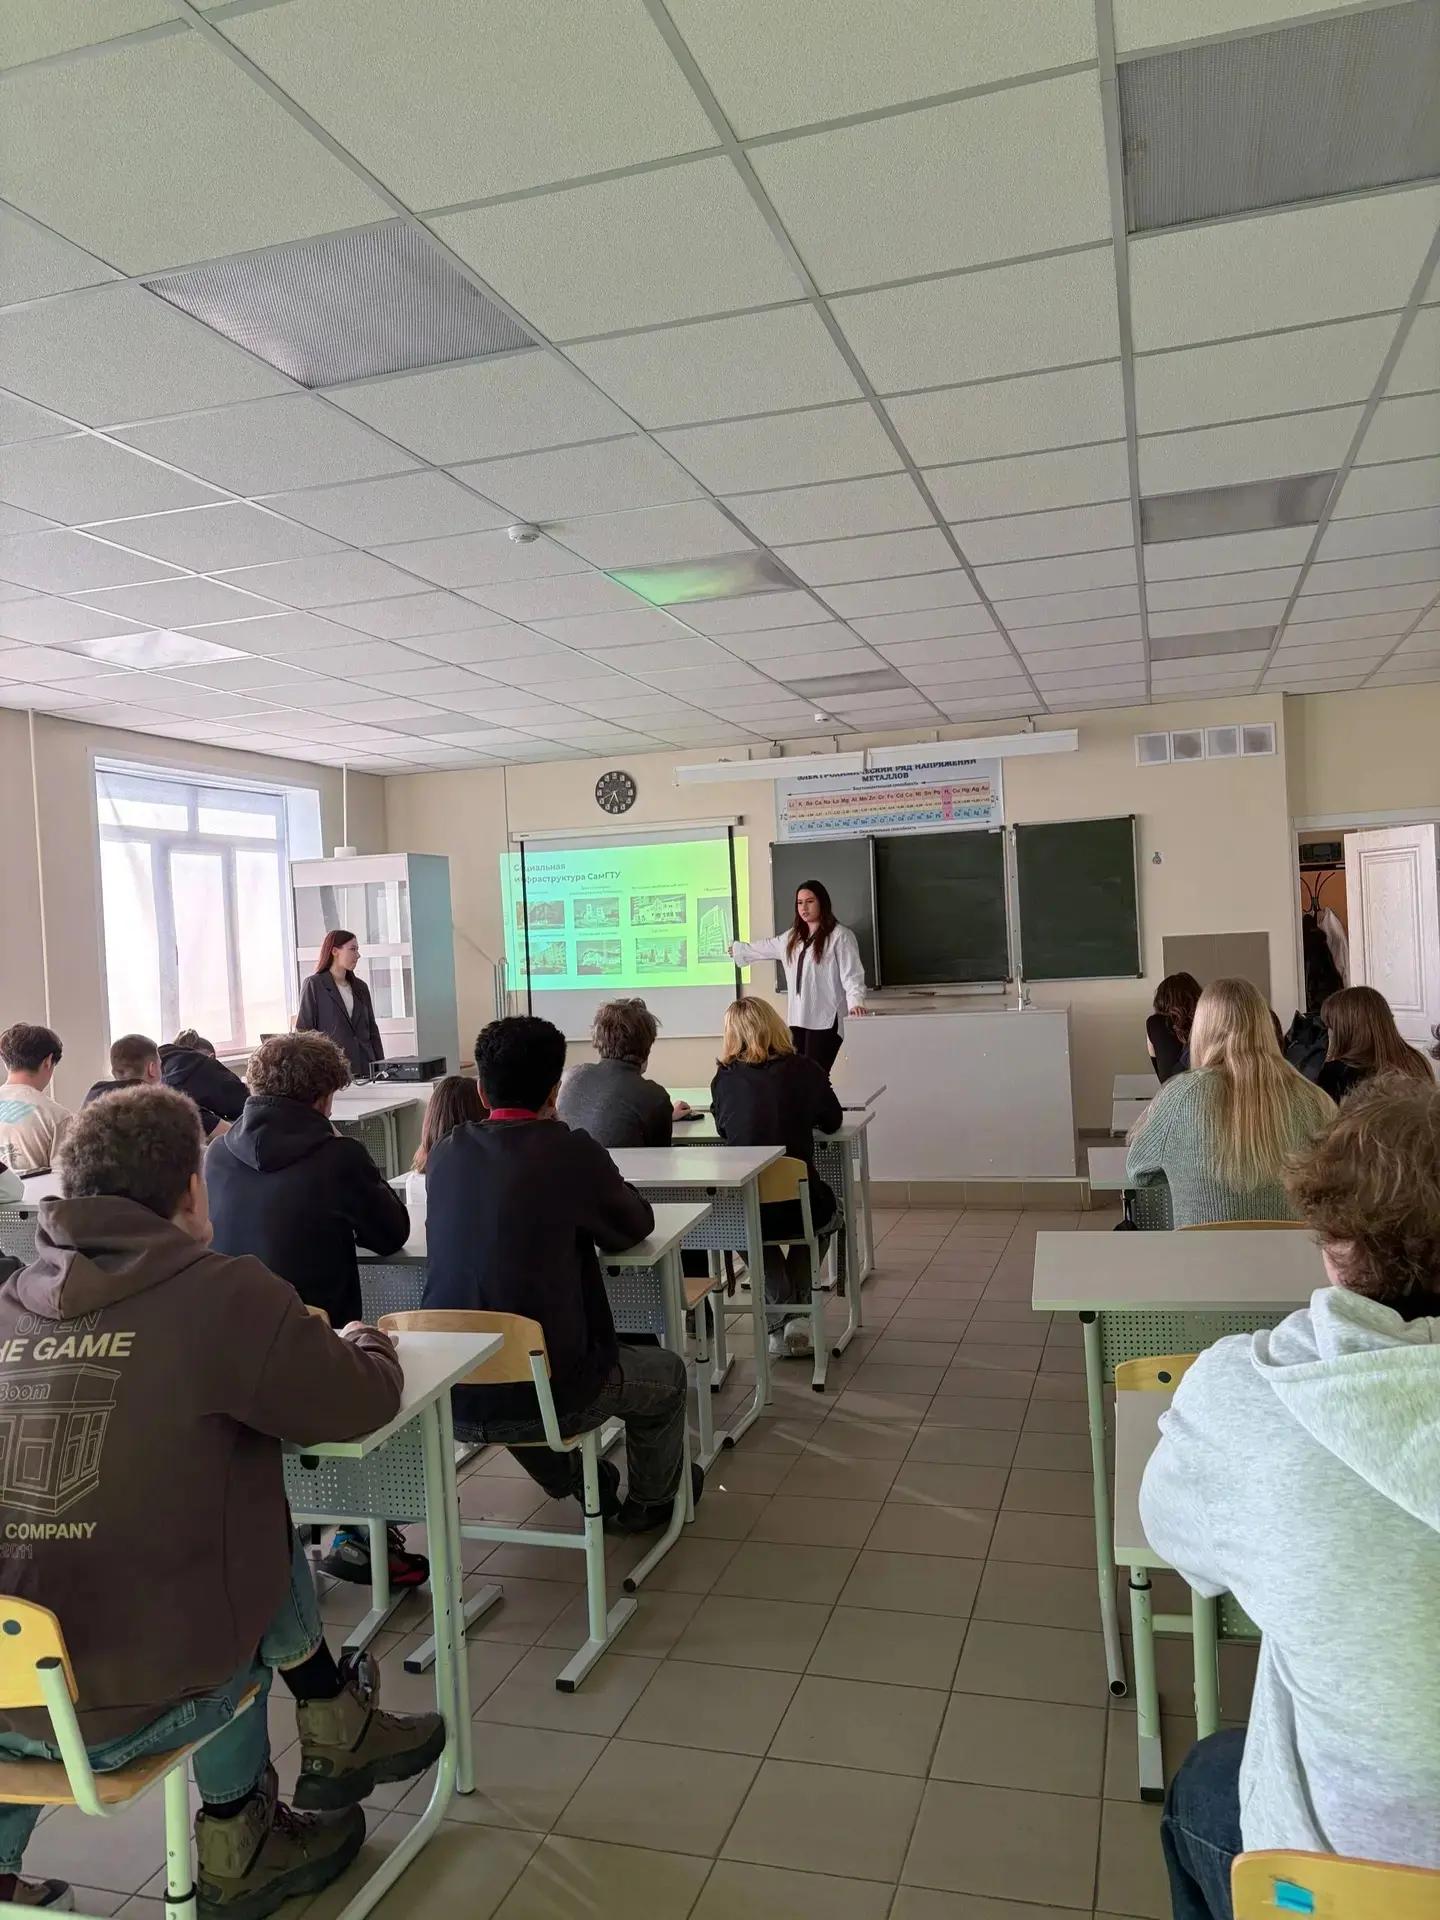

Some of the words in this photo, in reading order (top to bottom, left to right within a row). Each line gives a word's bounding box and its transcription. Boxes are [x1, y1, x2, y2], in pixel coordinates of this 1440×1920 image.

[862, 772, 909, 781] МЕТАЛЛОВ
[513, 864, 566, 872] Сциальная
[514, 873, 586, 884] ифраструктура
[587, 870, 621, 880] СамГТУ
[33, 1331, 136, 1361] GAME
[5, 1522, 97, 1540] COMPANY
